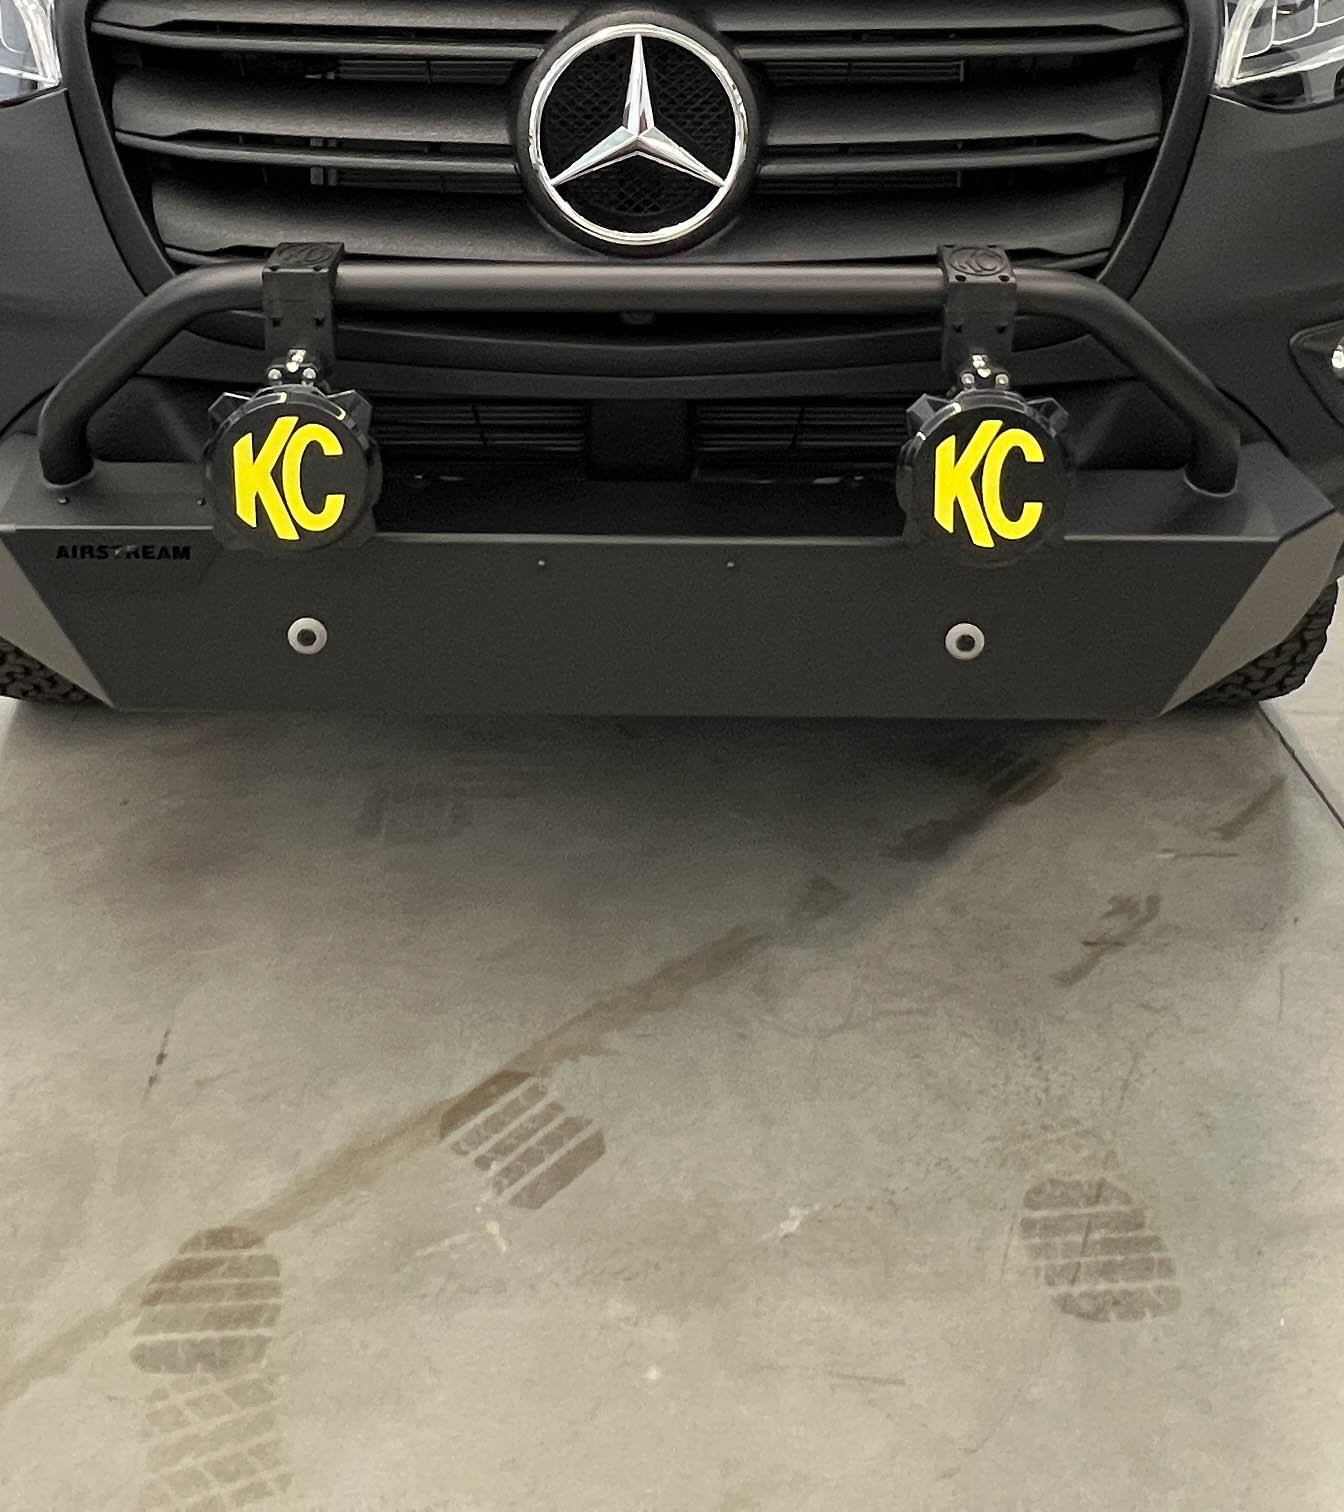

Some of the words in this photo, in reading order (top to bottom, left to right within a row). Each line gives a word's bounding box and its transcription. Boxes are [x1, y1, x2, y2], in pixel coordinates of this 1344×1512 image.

[233, 416, 346, 540] KC
[934, 419, 1045, 548] KC
[56, 545, 191, 561] AIRSTREAM
